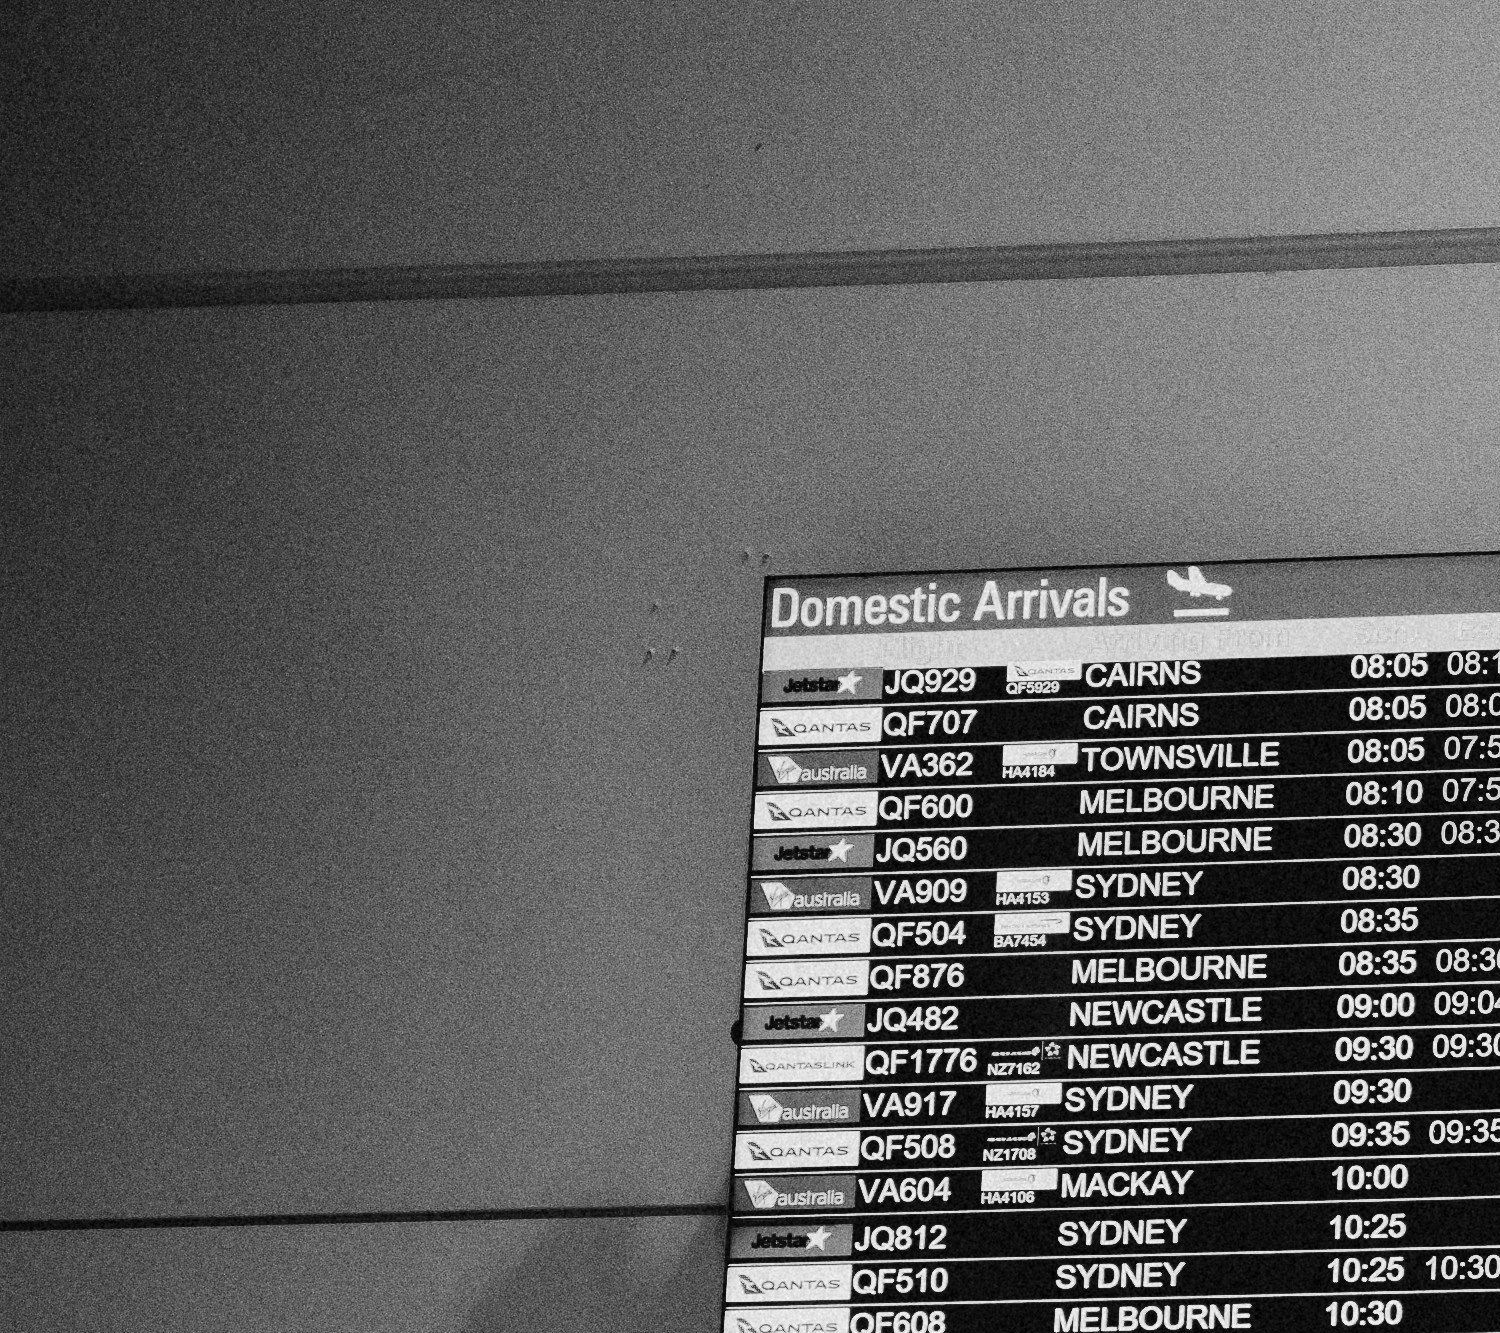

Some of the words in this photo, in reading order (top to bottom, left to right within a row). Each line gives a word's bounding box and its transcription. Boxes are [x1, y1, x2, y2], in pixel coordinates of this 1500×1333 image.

[771, 583, 961, 630] Domestic
[974, 577, 1130, 621] Arrivals
[885, 670, 976, 696] JQ929
[1006, 680, 1059, 694] QF5929
[1085, 661, 1201, 688] CAIRNS
[1350, 653, 1428, 678] 08:05
[884, 710, 977, 736] QF707
[1084, 703, 1199, 729] CAIRNS
[1349, 695, 1426, 721] 08:05
[874, 878, 967, 905] VA909
[996, 891, 1050, 906] HA4153
[1076, 871, 1203, 898] SYDNEY
[1342, 865, 1420, 890] 08:30
[866, 1048, 977, 1075] QF1776
[987, 1062, 1040, 1075] NZ7162
[1068, 1039, 1260, 1069] NEWCASTLE
[1335, 1035, 1414, 1061] 09:30
[853, 1268, 948, 1294] QF510
[1056, 1262, 1185, 1289] SYDNEY
[1328, 1256, 1404, 1283] 10:25
[1426, 1255, 1500, 1280] 10:30
